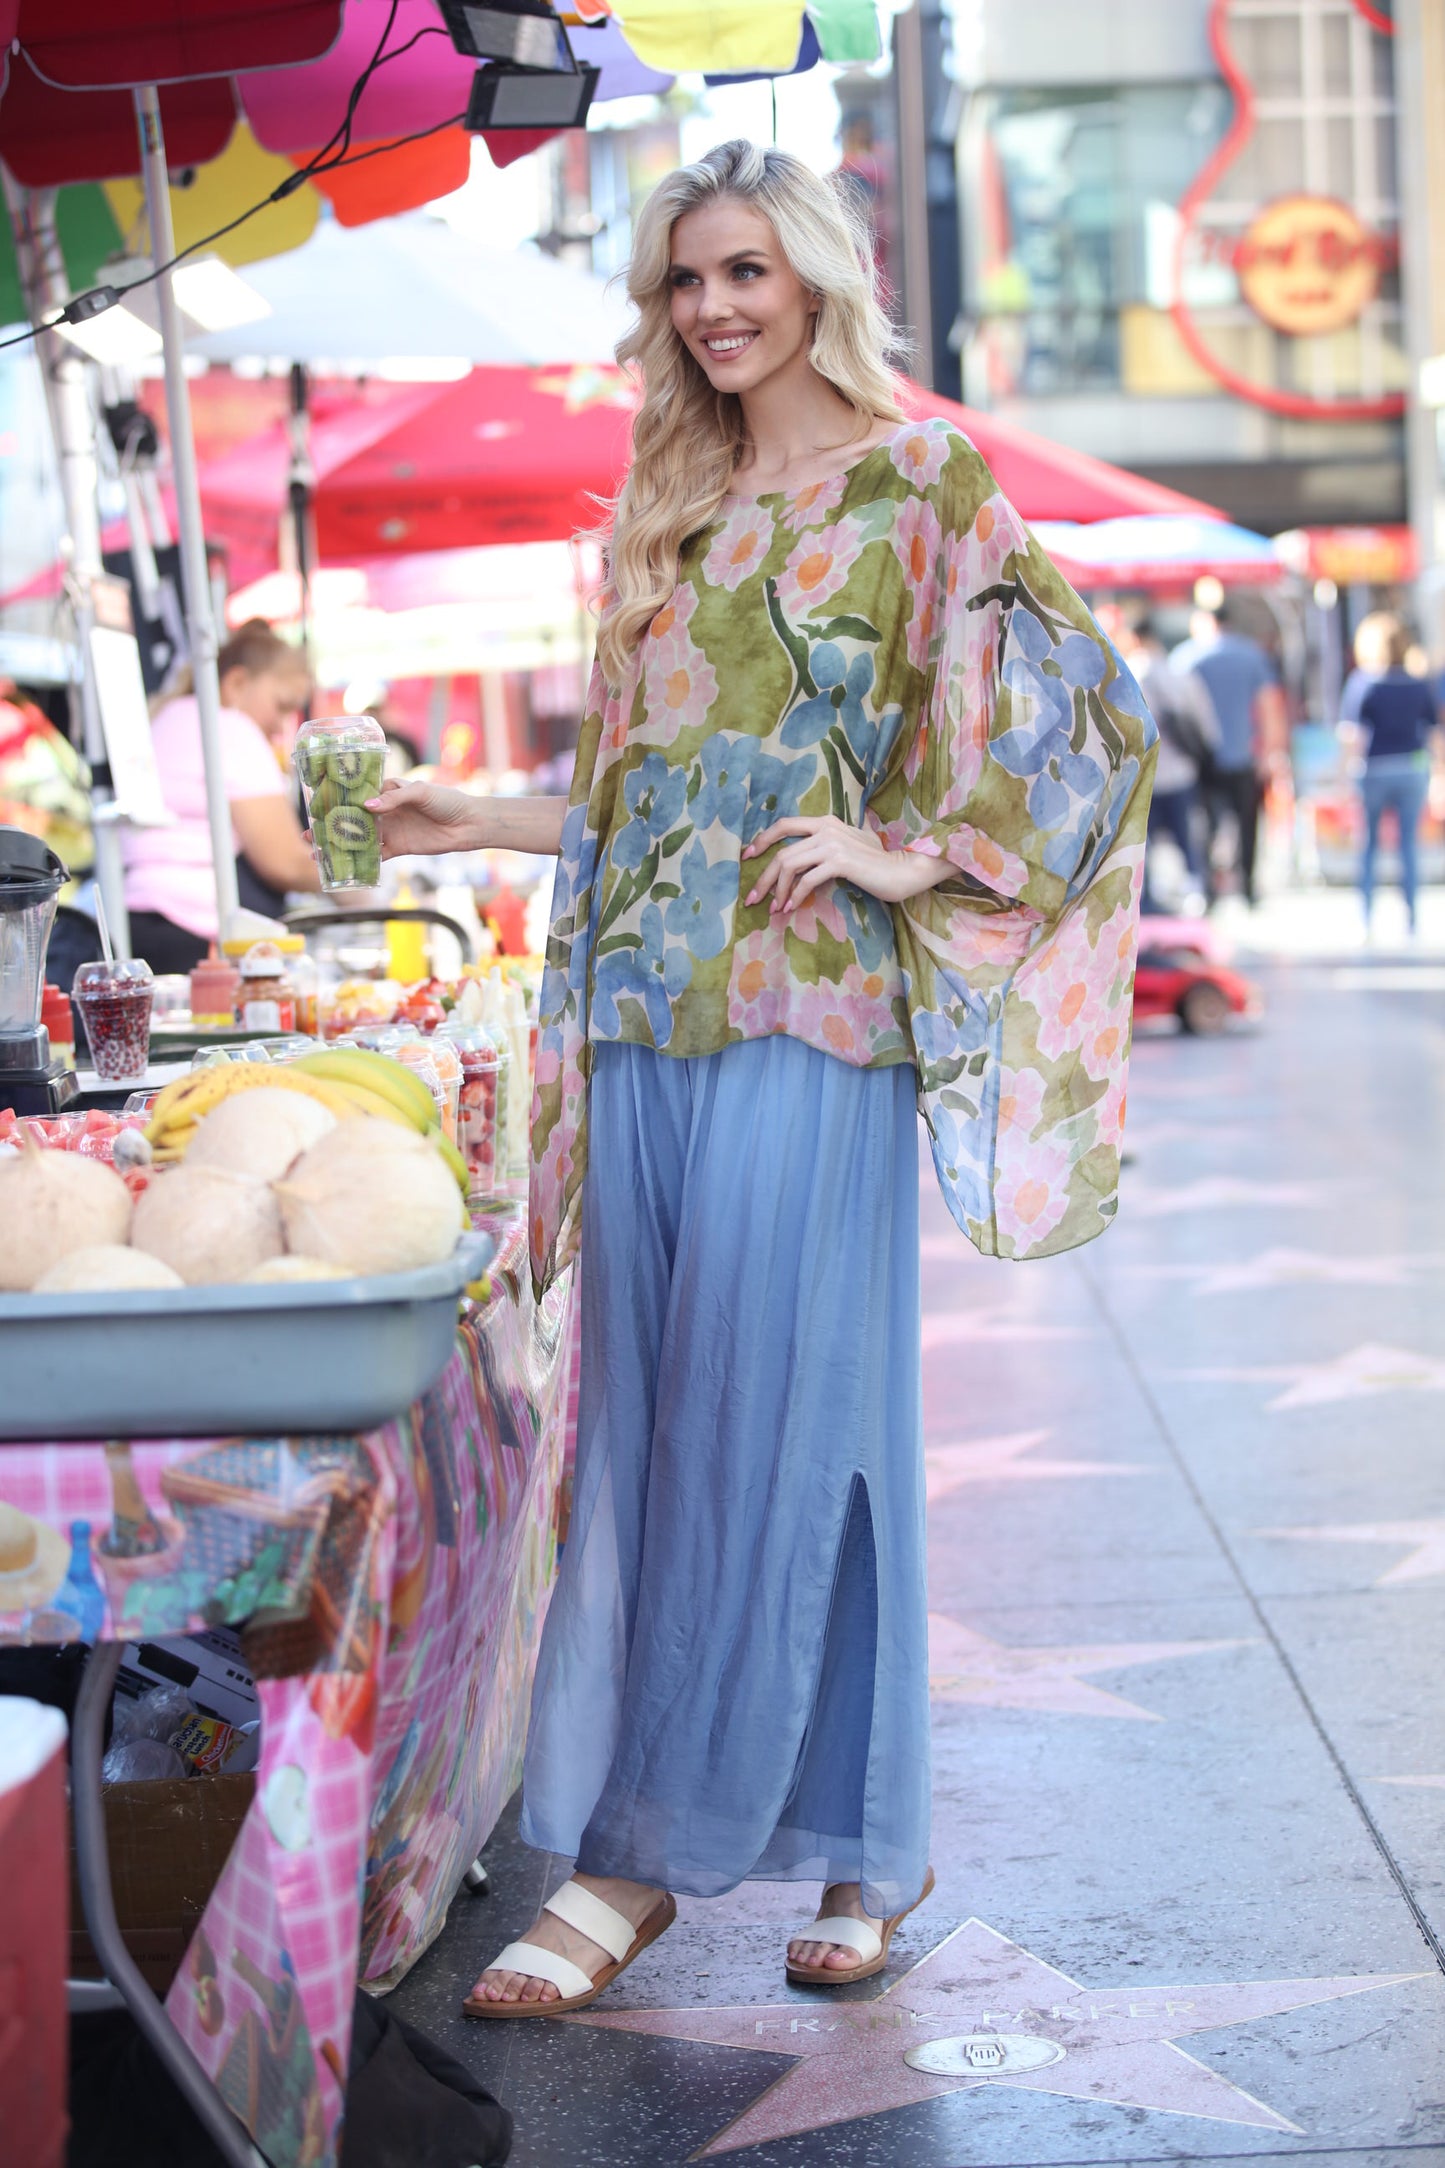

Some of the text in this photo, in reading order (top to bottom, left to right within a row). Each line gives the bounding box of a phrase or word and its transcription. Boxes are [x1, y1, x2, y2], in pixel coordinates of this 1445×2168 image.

[172, 1718, 202, 1748] aruchan
[755, 2000, 1196, 2034] FRANK PARKER
